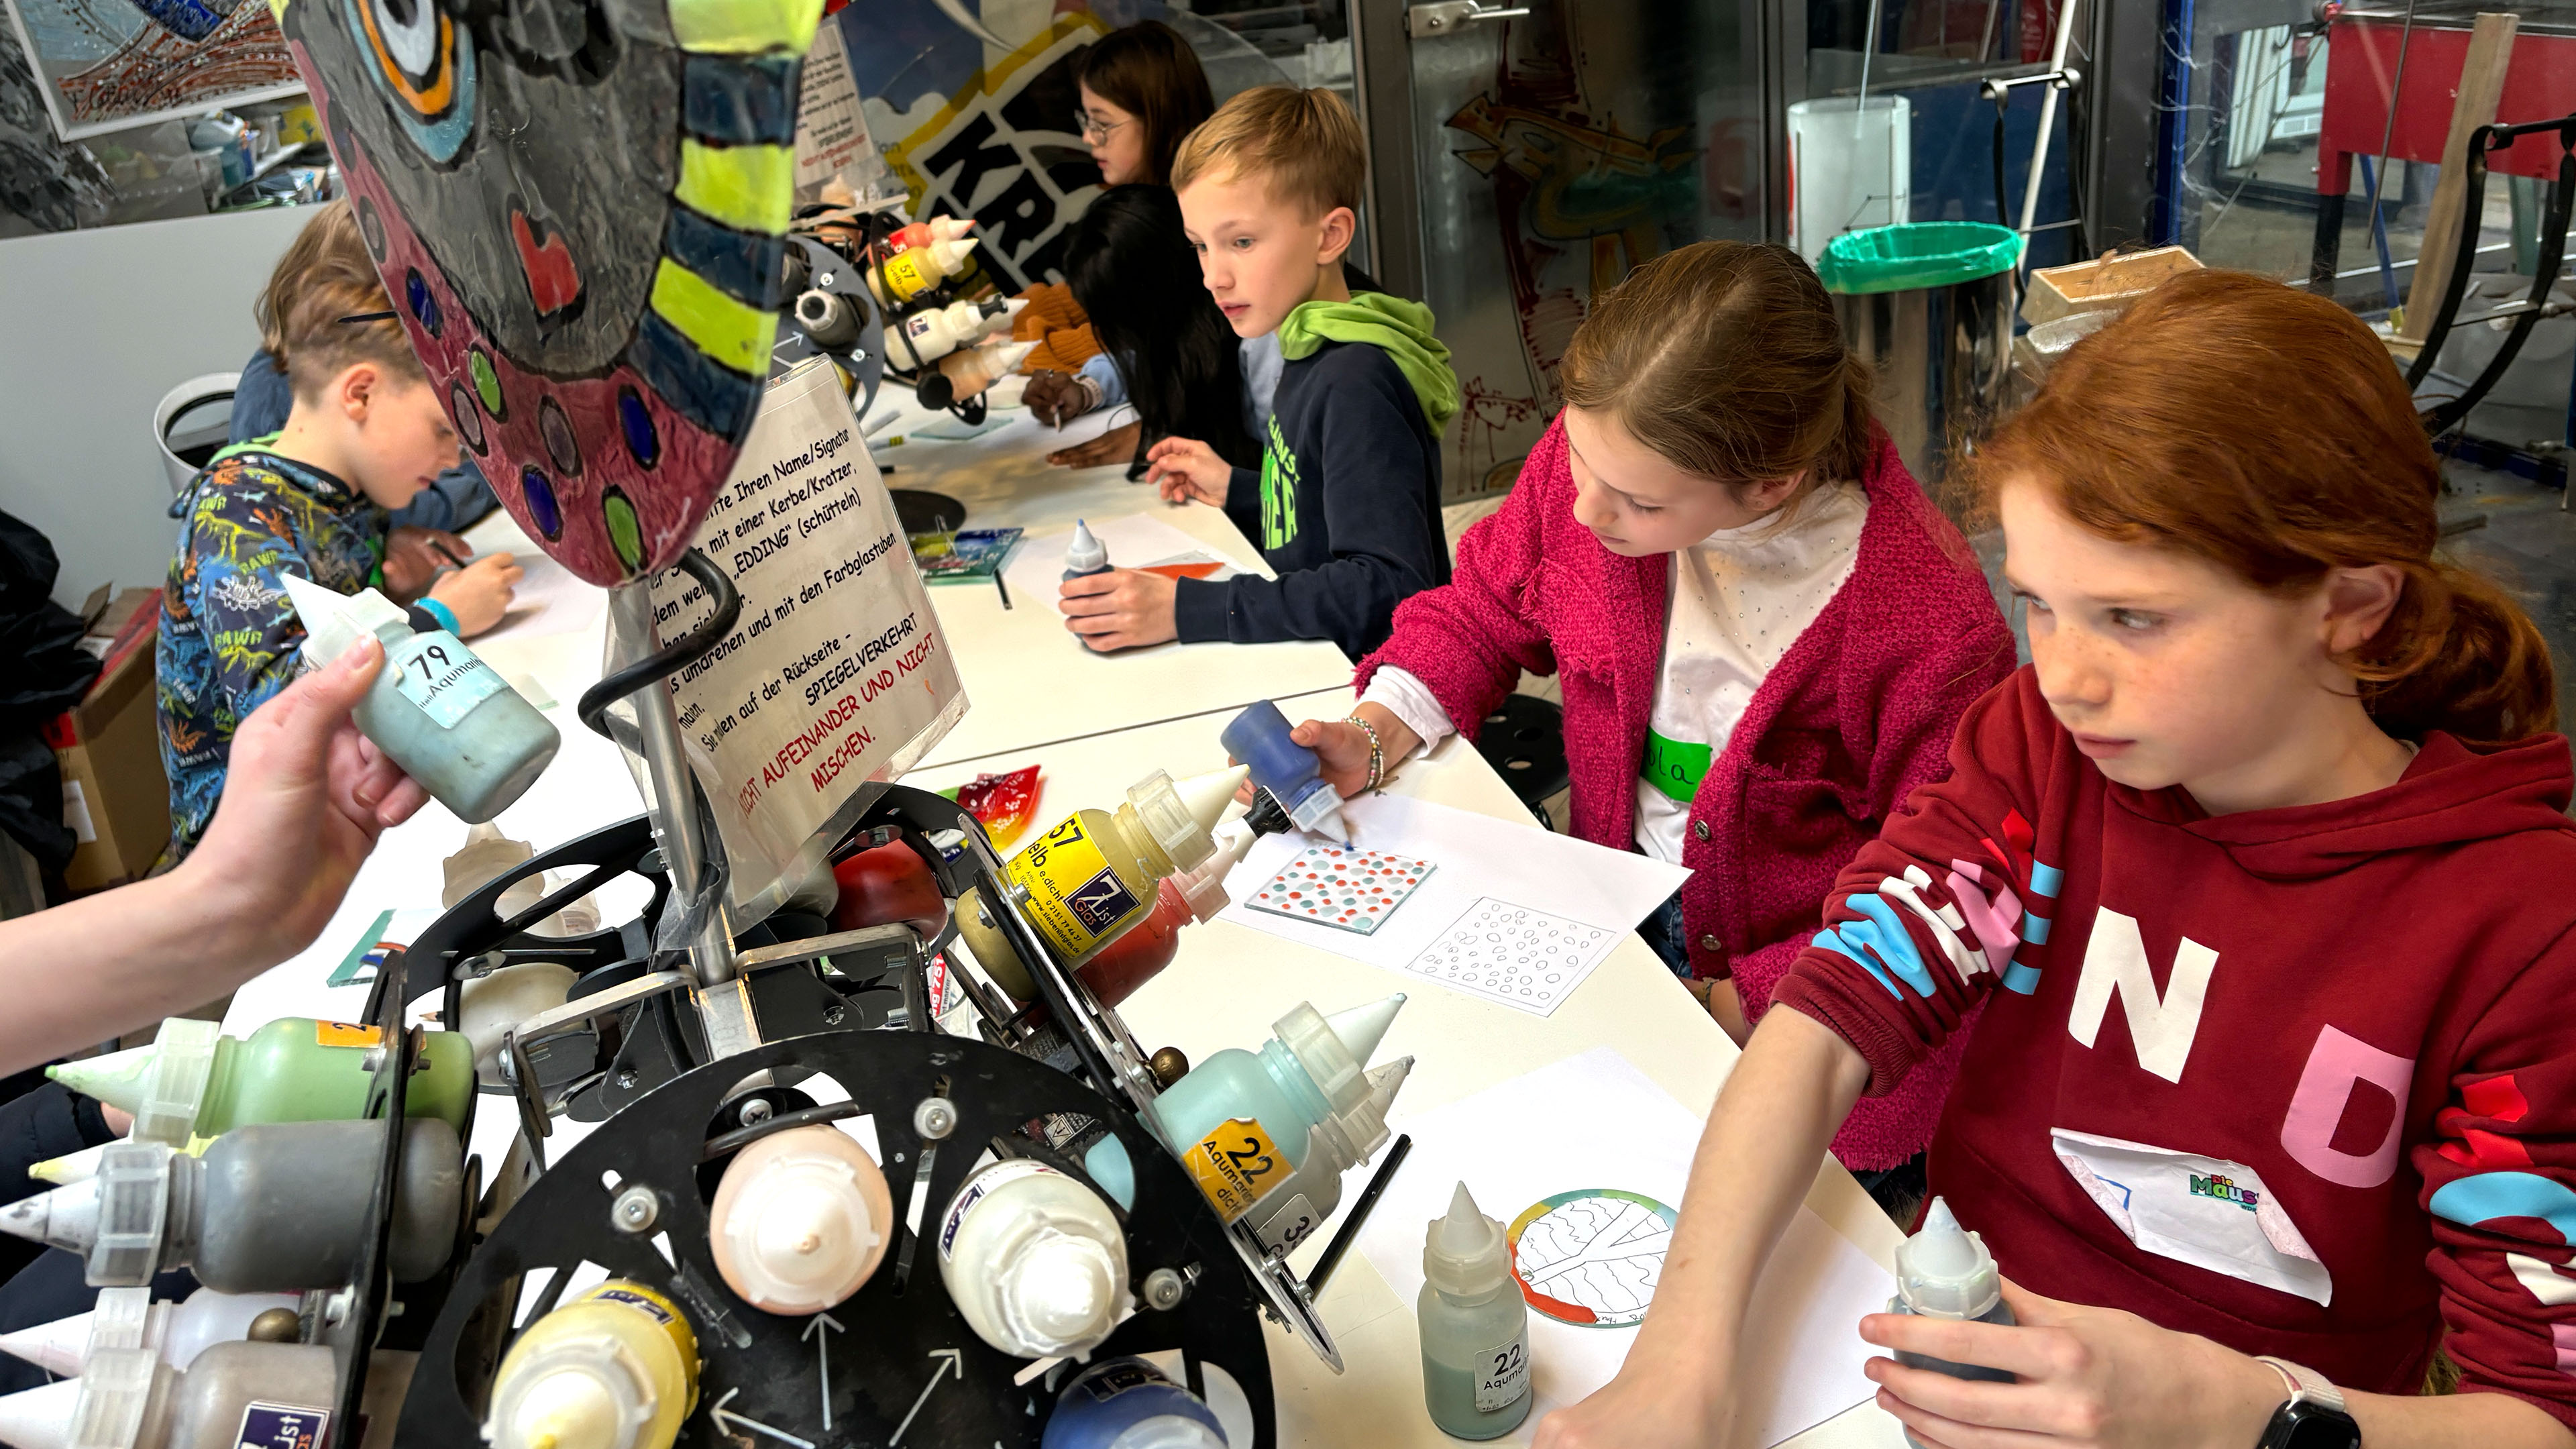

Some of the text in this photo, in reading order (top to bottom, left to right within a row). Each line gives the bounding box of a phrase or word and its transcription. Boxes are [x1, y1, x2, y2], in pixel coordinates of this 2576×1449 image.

[900, 264, 916, 279] 57
[734, 473, 772, 502] Ihren
[773, 429, 849, 481] Name/Signatur
[709, 529, 731, 554] mit
[735, 511, 765, 538] einer
[768, 462, 857, 519] Kerbe/Kratzer,
[798, 487, 861, 539] (schütteln)
[749, 609, 772, 638] und
[775, 596, 796, 621] mit
[800, 582, 824, 604] den
[824, 532, 897, 590] Farbglastuben
[407, 645, 451, 680] 79
[806, 612, 918, 706] SPIEGELVERKEHRT
[739, 691, 759, 719] auf
[762, 679, 782, 701] der
[782, 639, 841, 684] Rückseite
[678, 703, 706, 730] malen.
[763, 695, 861, 788] AUFEINANDER
[859, 669, 894, 703] UND
[896, 632, 935, 678] NICHT
[810, 725, 877, 793] MISCHEN.
[1648, 746, 1695, 785] ola
[1048, 817, 1084, 848] 57
[1028, 839, 1049, 867] elb
[1050, 905, 1063, 920] 2151
[1061, 920, 1069, 928] 79
[1068, 928, 1076, 936] 46
[1075, 900, 1097, 926] Glas
[932, 958, 945, 988] 751
[1226, 1137, 1273, 1185] 22
[2190, 1174, 2257, 1205] Maus
[2210, 1174, 2233, 1186] Die
[1494, 1344, 1521, 1377] 22
